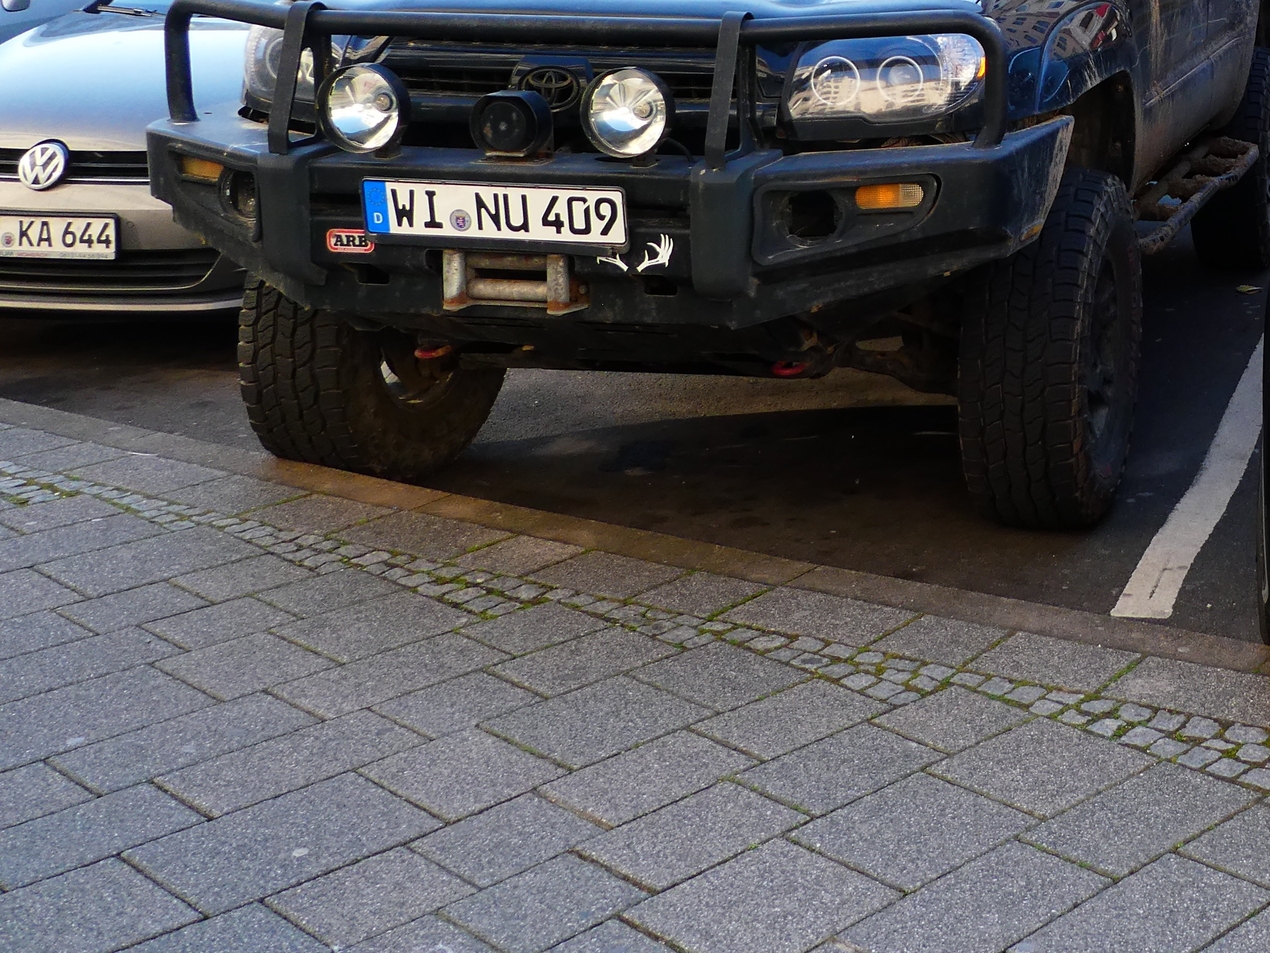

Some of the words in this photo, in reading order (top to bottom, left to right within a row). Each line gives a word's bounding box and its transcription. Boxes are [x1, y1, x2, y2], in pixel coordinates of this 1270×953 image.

[373, 212, 384, 224] D
[390, 188, 444, 229] WI
[475, 192, 530, 233] NU
[541, 195, 618, 236] 409
[18, 219, 53, 247] KA
[61, 221, 112, 248] 644
[333, 234, 368, 248] ARB
